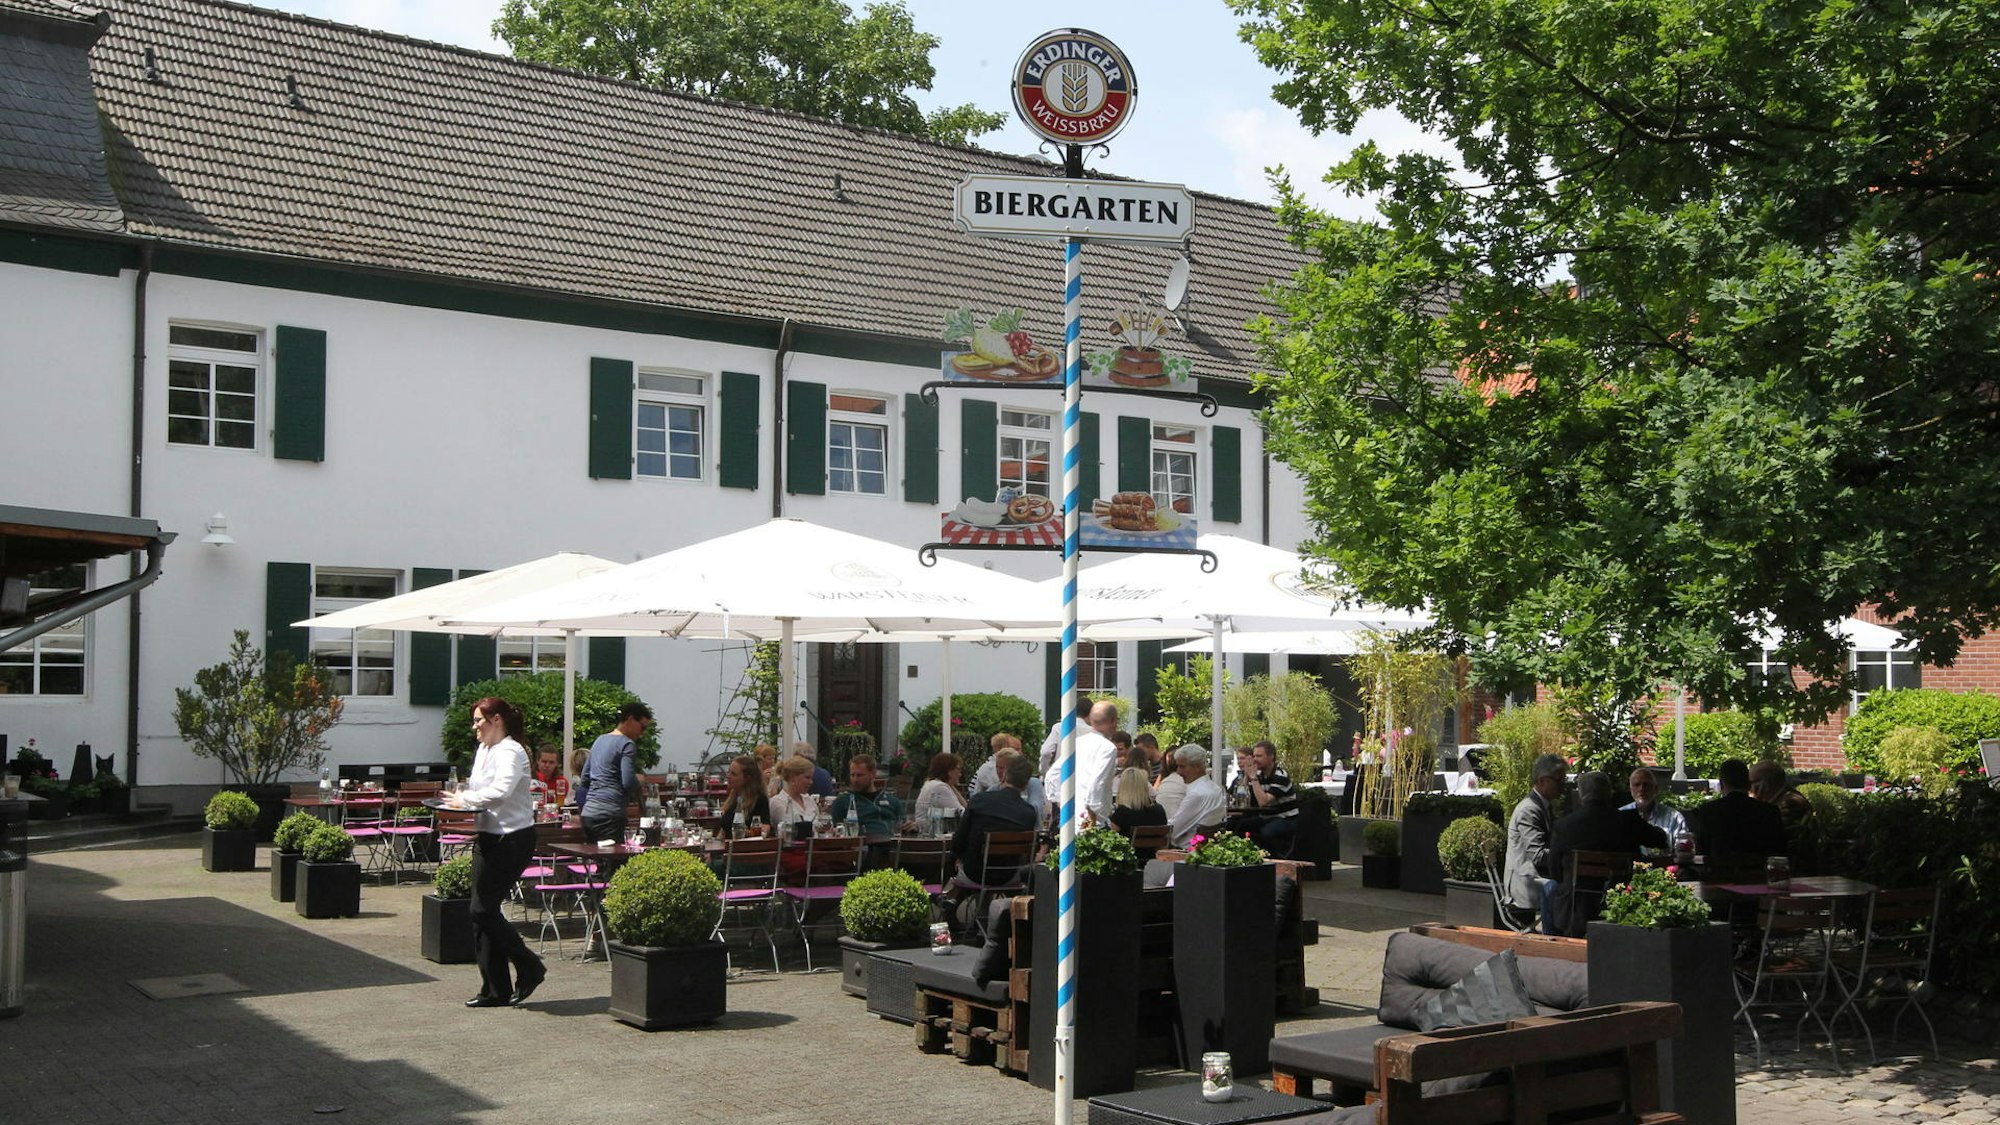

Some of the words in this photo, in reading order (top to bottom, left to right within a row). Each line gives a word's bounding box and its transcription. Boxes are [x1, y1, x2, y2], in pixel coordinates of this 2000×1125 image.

[1026, 41, 1121, 84] ERDINGER
[1033, 99, 1119, 134] WEISSBRÄU
[975, 190, 1179, 225] BIERGARTEN
